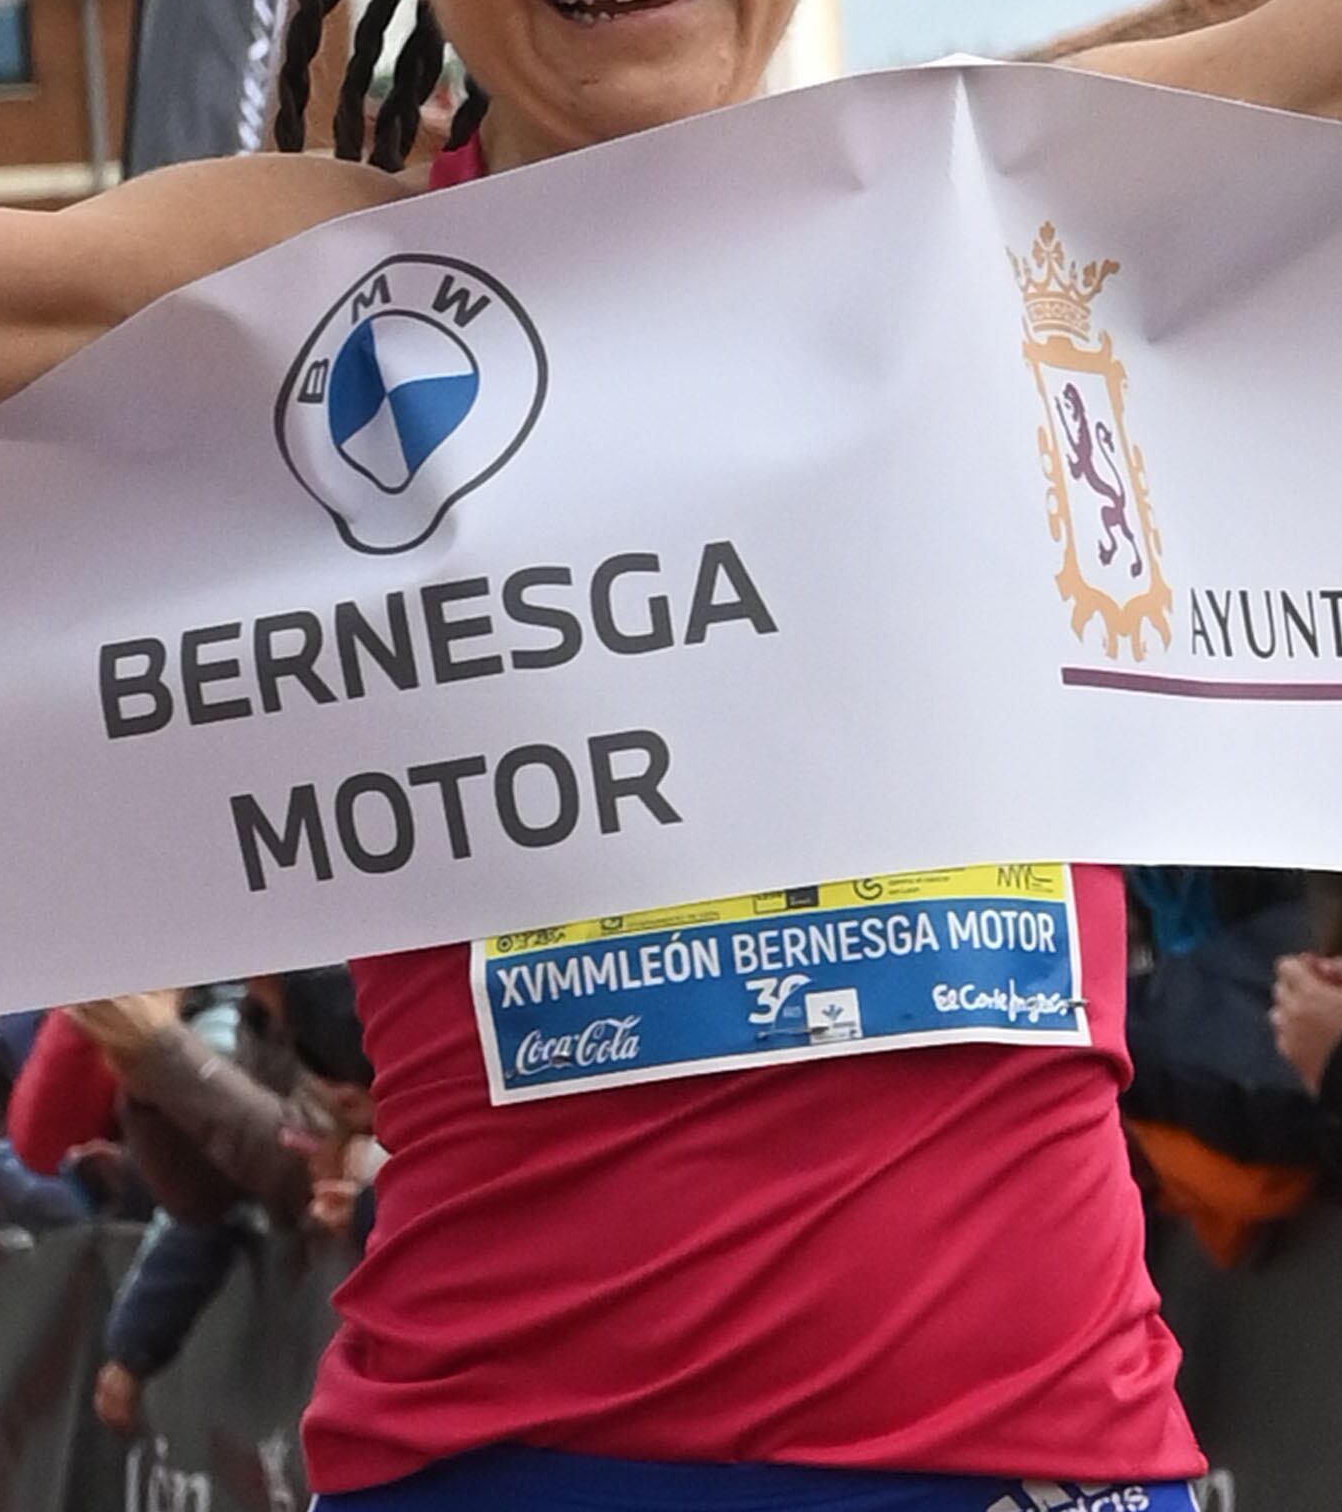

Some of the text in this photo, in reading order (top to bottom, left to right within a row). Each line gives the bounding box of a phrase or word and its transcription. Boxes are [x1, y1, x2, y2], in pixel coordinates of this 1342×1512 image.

[299, 273, 491, 405] BMW
[98, 540, 779, 739] BERNESGA
[229, 728, 683, 892] MOTOR
[732, 911, 940, 975] BERNESGA
[947, 909, 1057, 954] MOTOR
[505, 1014, 643, 1080] Coca-Cola
